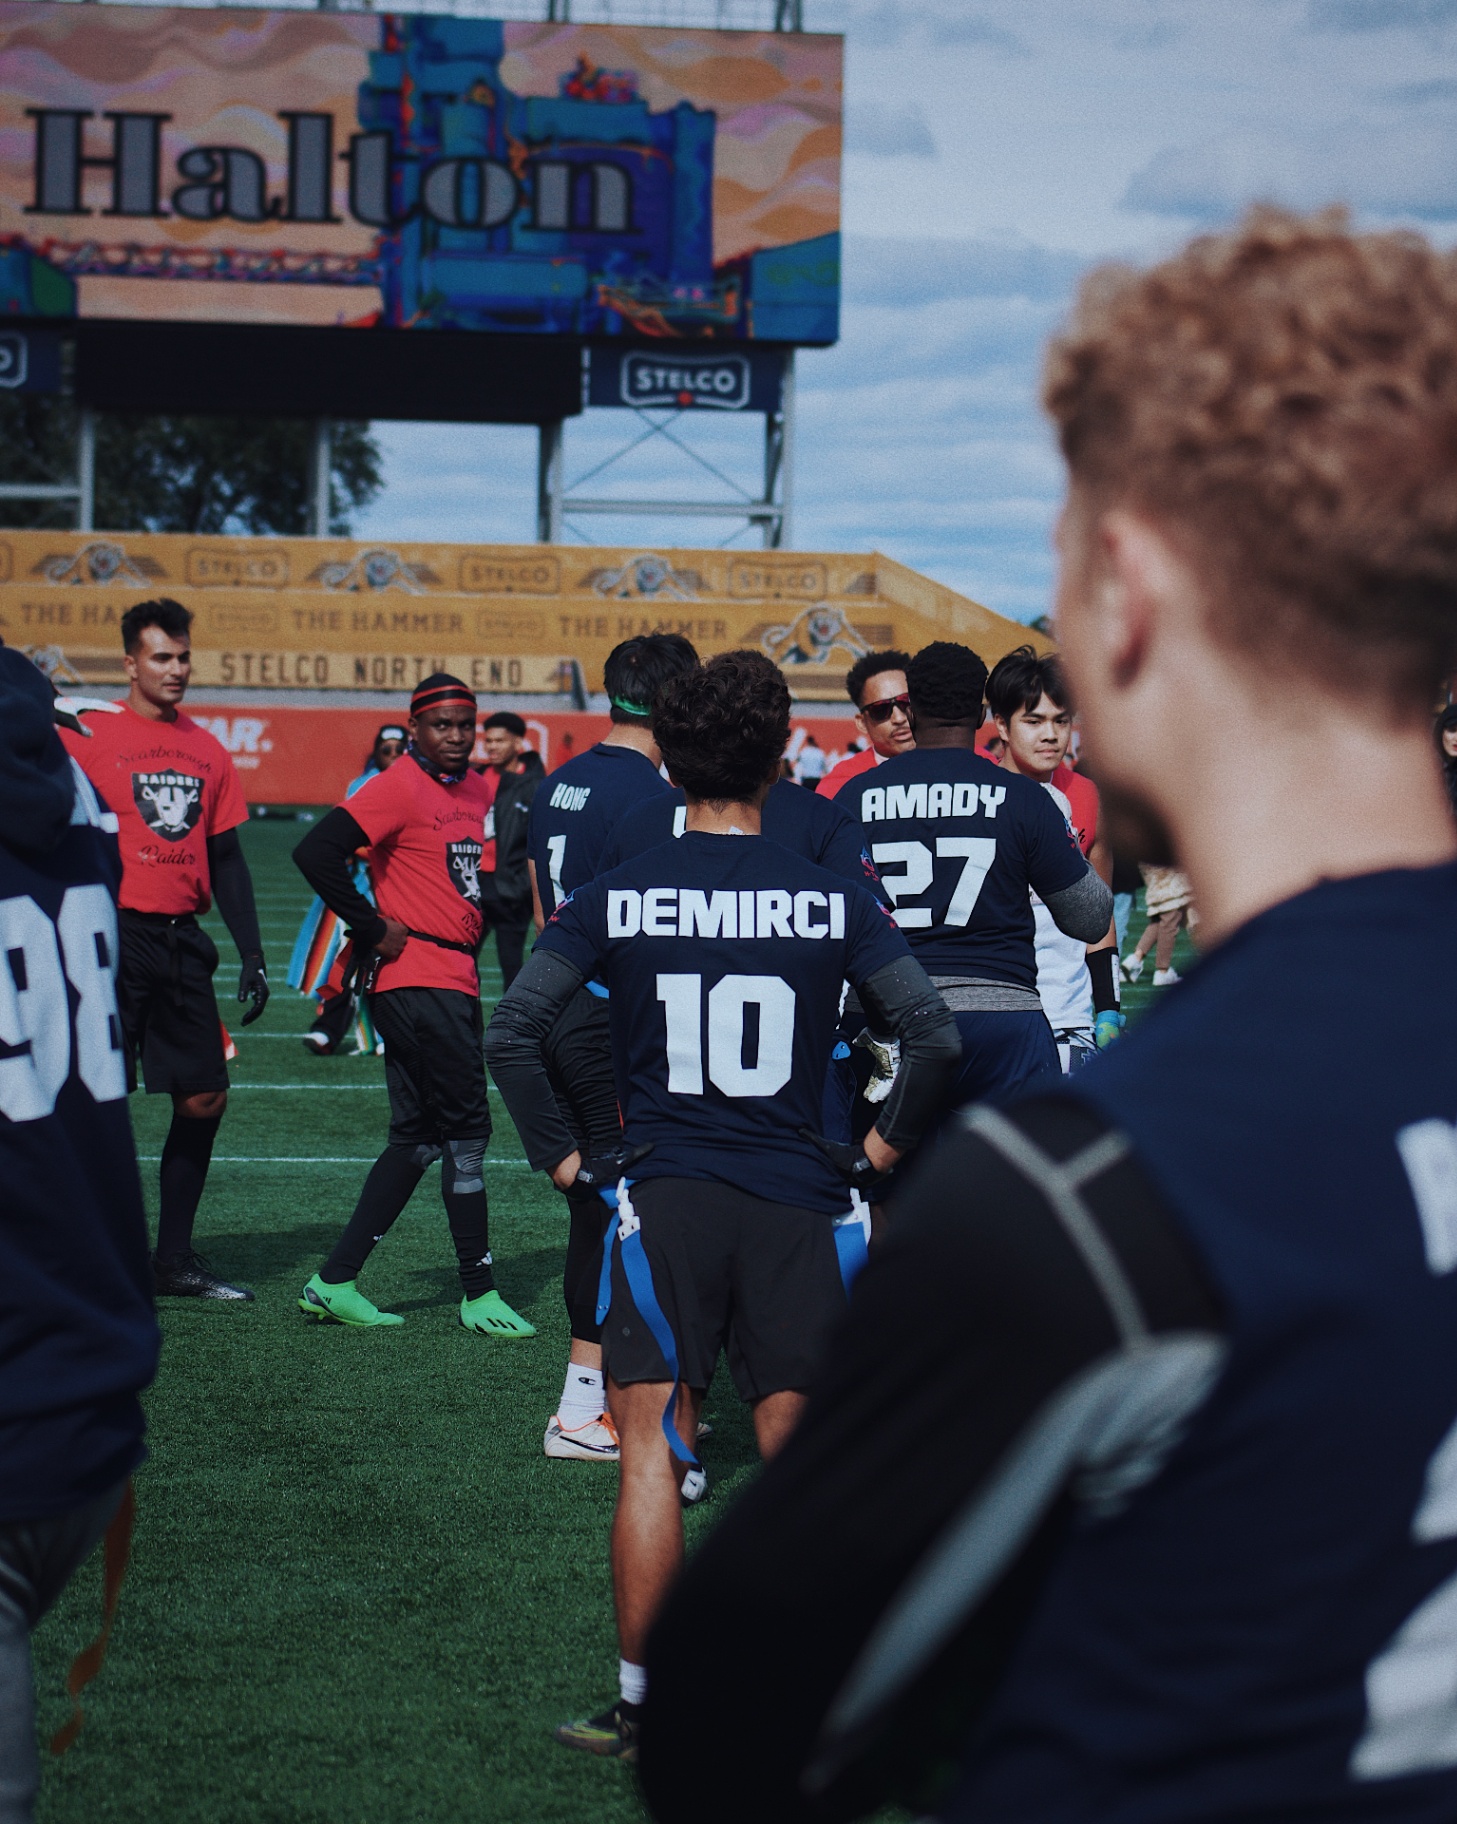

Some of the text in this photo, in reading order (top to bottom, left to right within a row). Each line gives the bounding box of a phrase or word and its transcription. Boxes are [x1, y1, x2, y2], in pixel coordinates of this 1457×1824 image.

[23, 107, 643, 236] Halton
[636, 366, 736, 393] STELCO
[470, 565, 551, 583] STELCO
[21, 603, 72, 625] THE
[293, 609, 341, 631] THE
[352, 611, 464, 634] HAMMER
[559, 615, 609, 638] THE
[617, 617, 727, 640] HAMMER
[221, 652, 330, 684] STELCO
[471, 658, 523, 688] END
[138, 773, 201, 788] RAIDERS
[550, 783, 591, 811] HONG
[862, 783, 1007, 823] AMADY
[451, 843, 484, 855] RAIDER
[872, 837, 997, 928] 27
[607, 887, 845, 939] DEMIRCI
[0, 883, 128, 1123] 98
[656, 973, 796, 1098] 10
